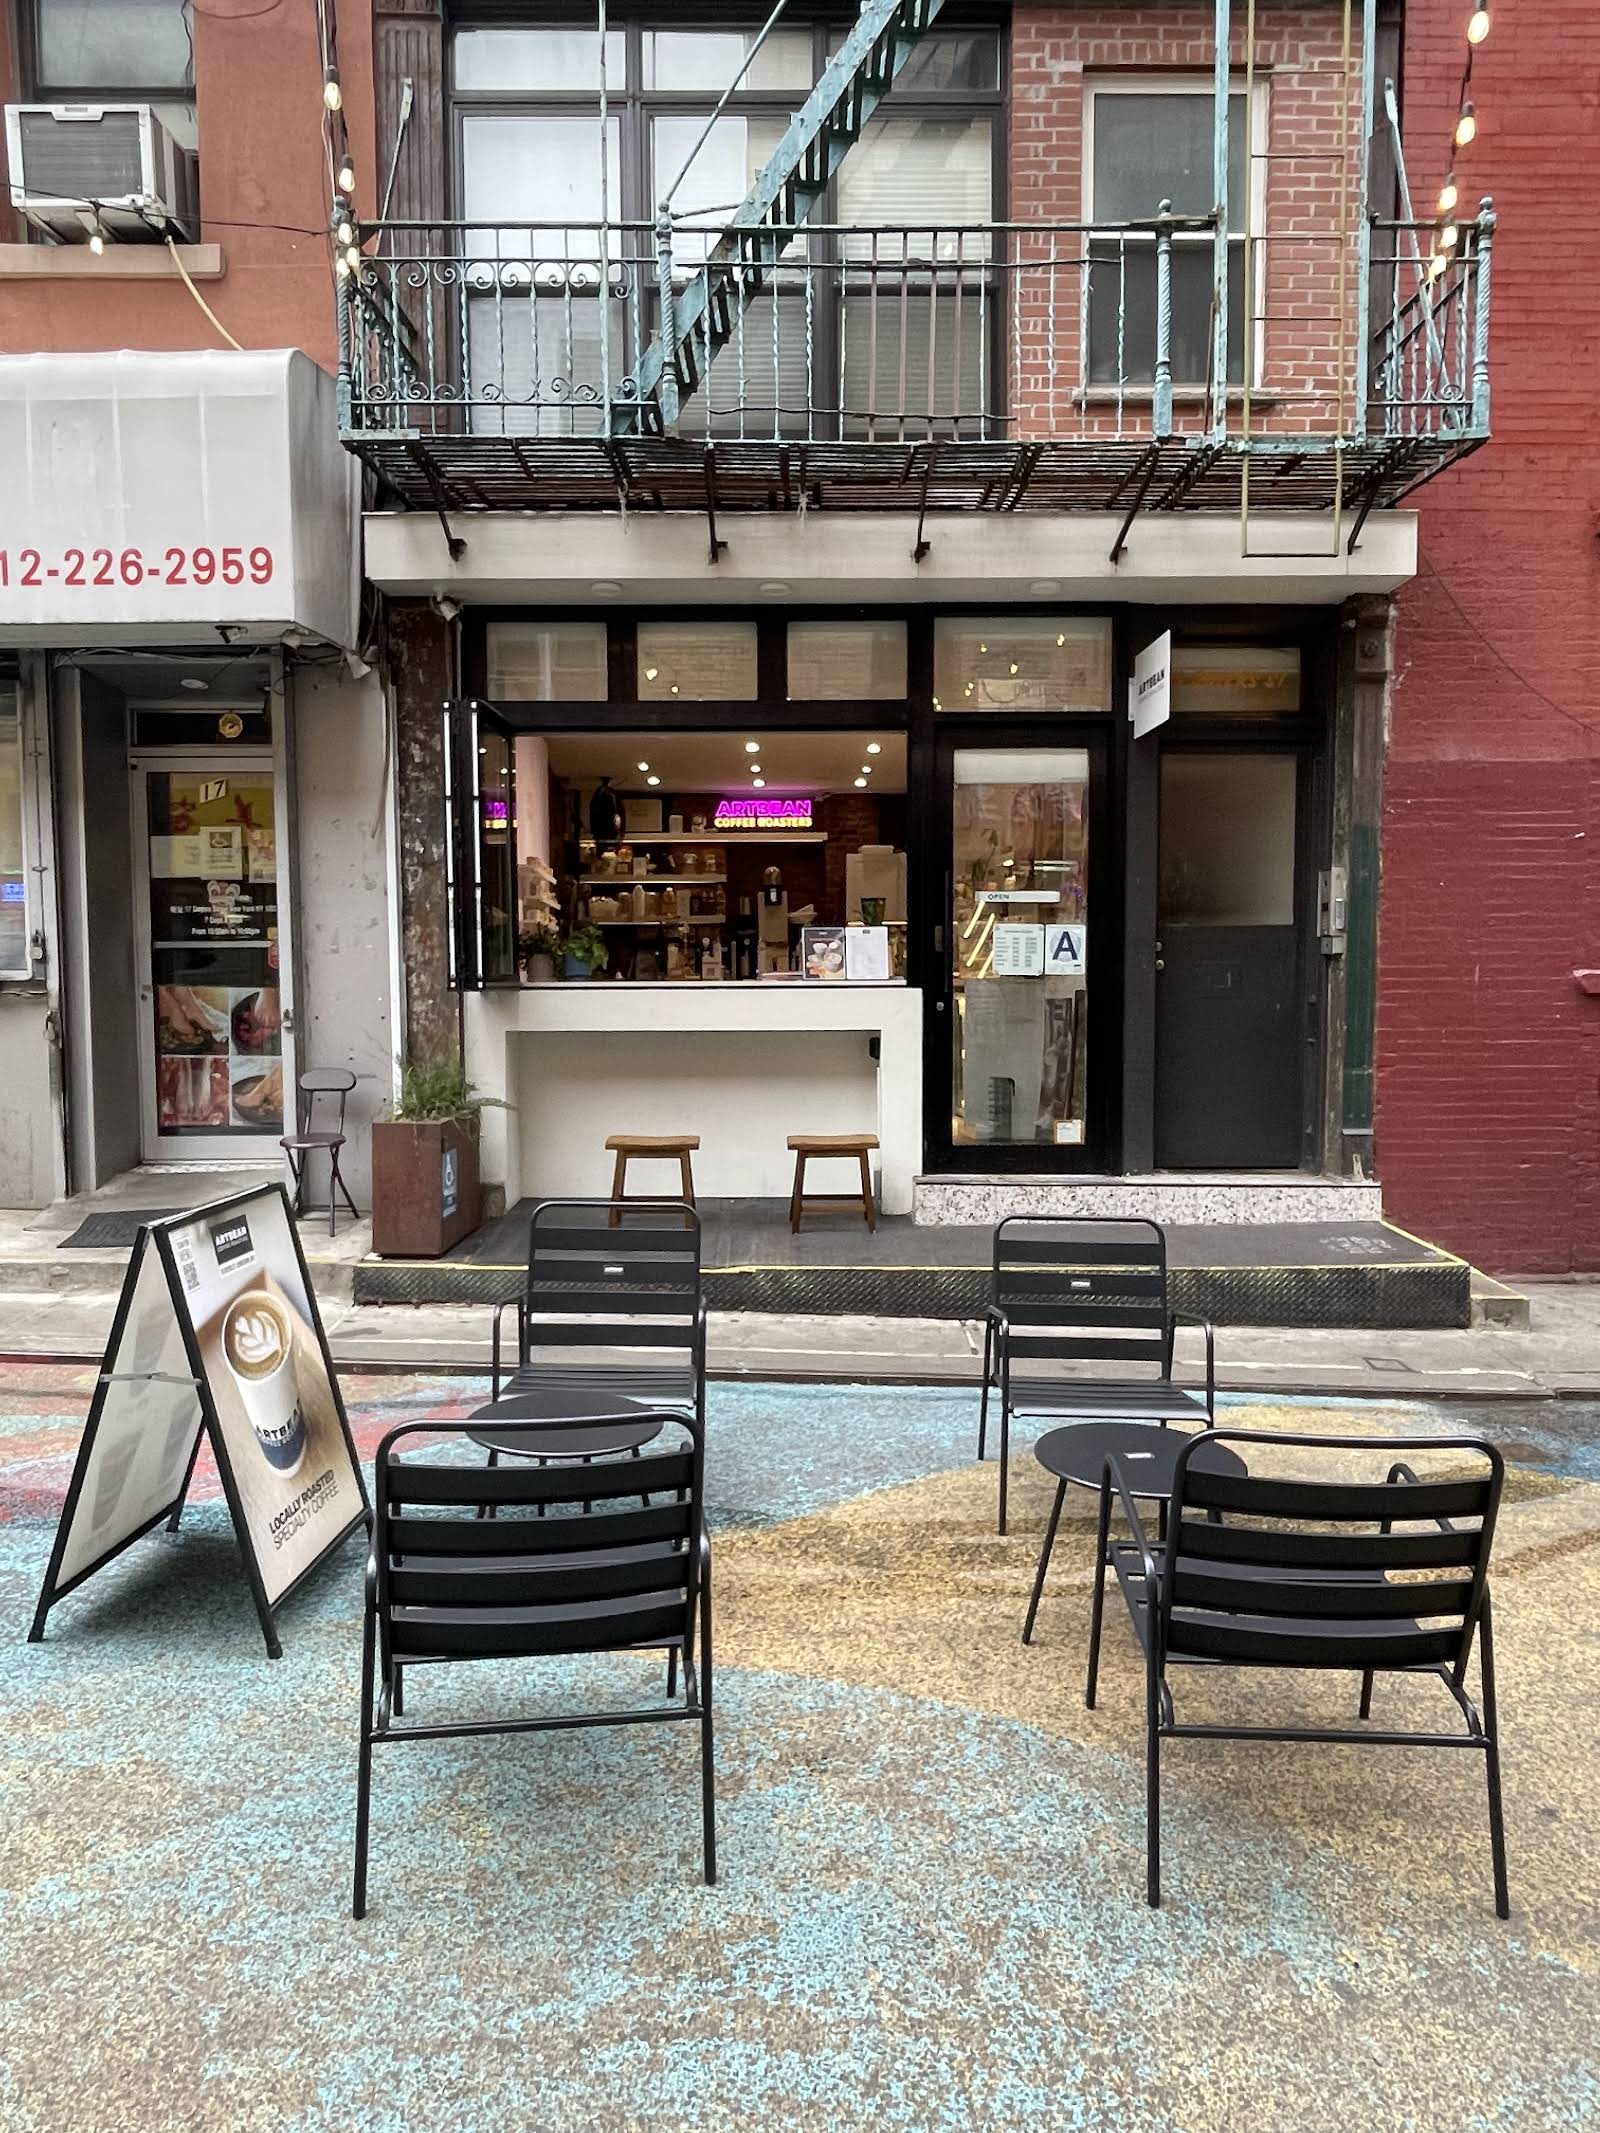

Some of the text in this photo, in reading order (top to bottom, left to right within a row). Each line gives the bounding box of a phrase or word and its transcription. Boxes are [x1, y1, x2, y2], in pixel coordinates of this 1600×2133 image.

[204, 780, 225, 800] 17
[715, 800, 812, 817] ARTBEAN
[714, 817, 812, 828] COFFEE ROASTERS
[1052, 931, 1079, 960] A
[269, 1469, 335, 1534] LOCALLY ROASTED
[273, 1484, 340, 1550] SPECIALTY COFFEE
